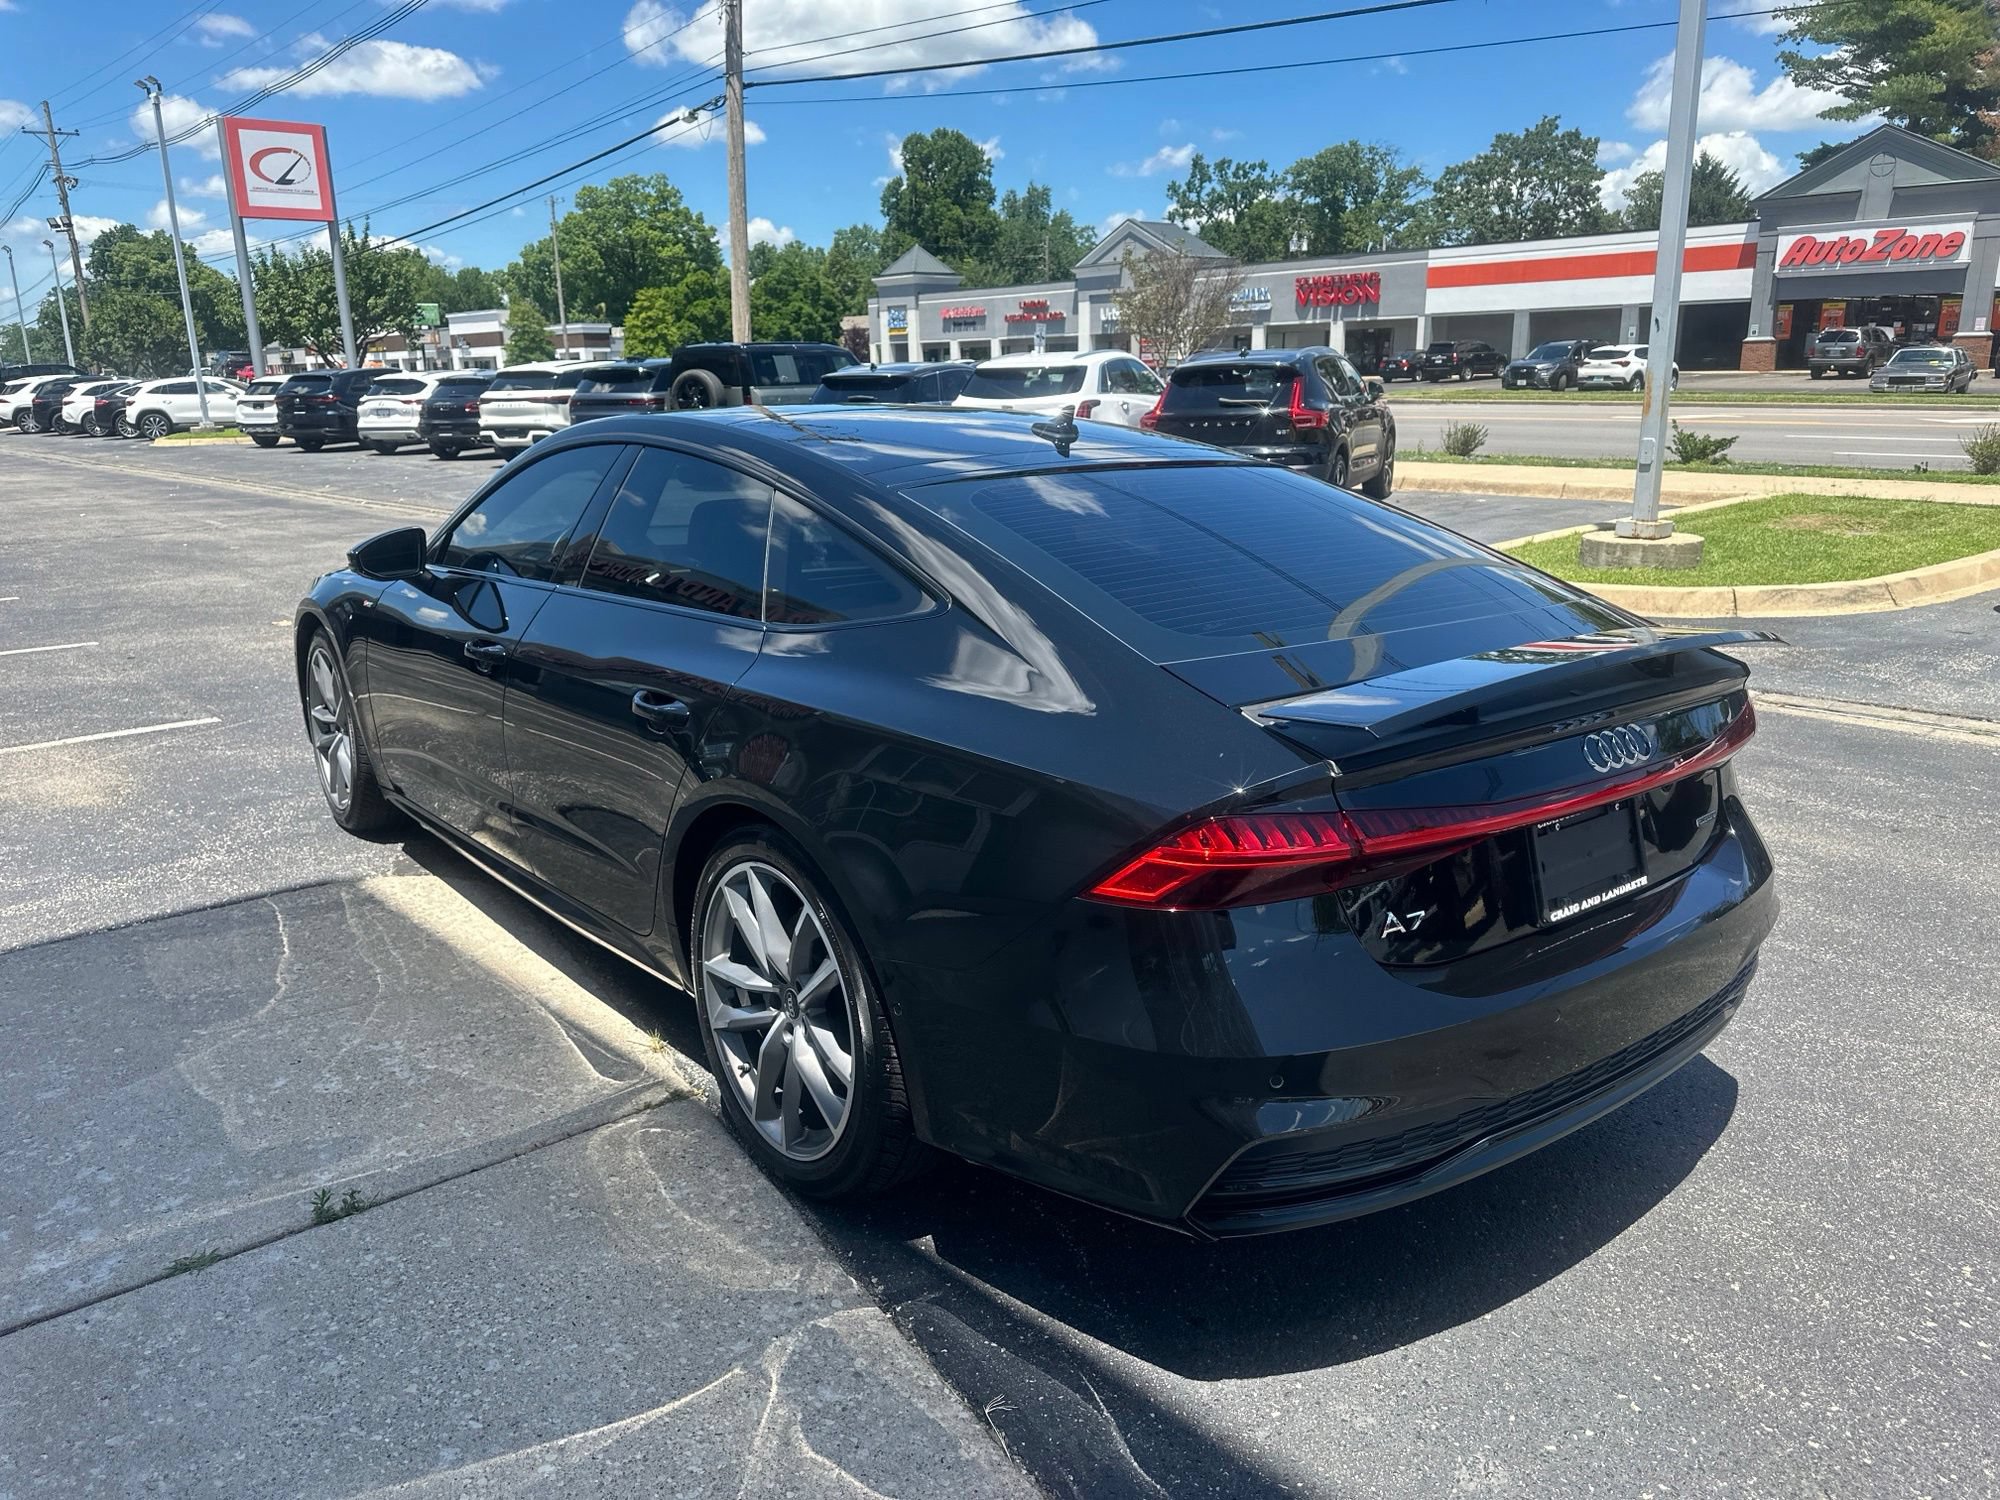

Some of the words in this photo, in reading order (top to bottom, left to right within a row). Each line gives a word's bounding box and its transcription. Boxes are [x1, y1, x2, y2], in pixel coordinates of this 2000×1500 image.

[1779, 228, 1966, 267] AutoZone
[1296, 282, 1381, 308] VISION
[1189, 420, 1251, 428] VOLVO
[1550, 902, 1579, 922] CRAIG
[1581, 895, 1601, 911] AND
[1602, 875, 1648, 902] LANDRETH
[1381, 910, 1426, 939] A7
